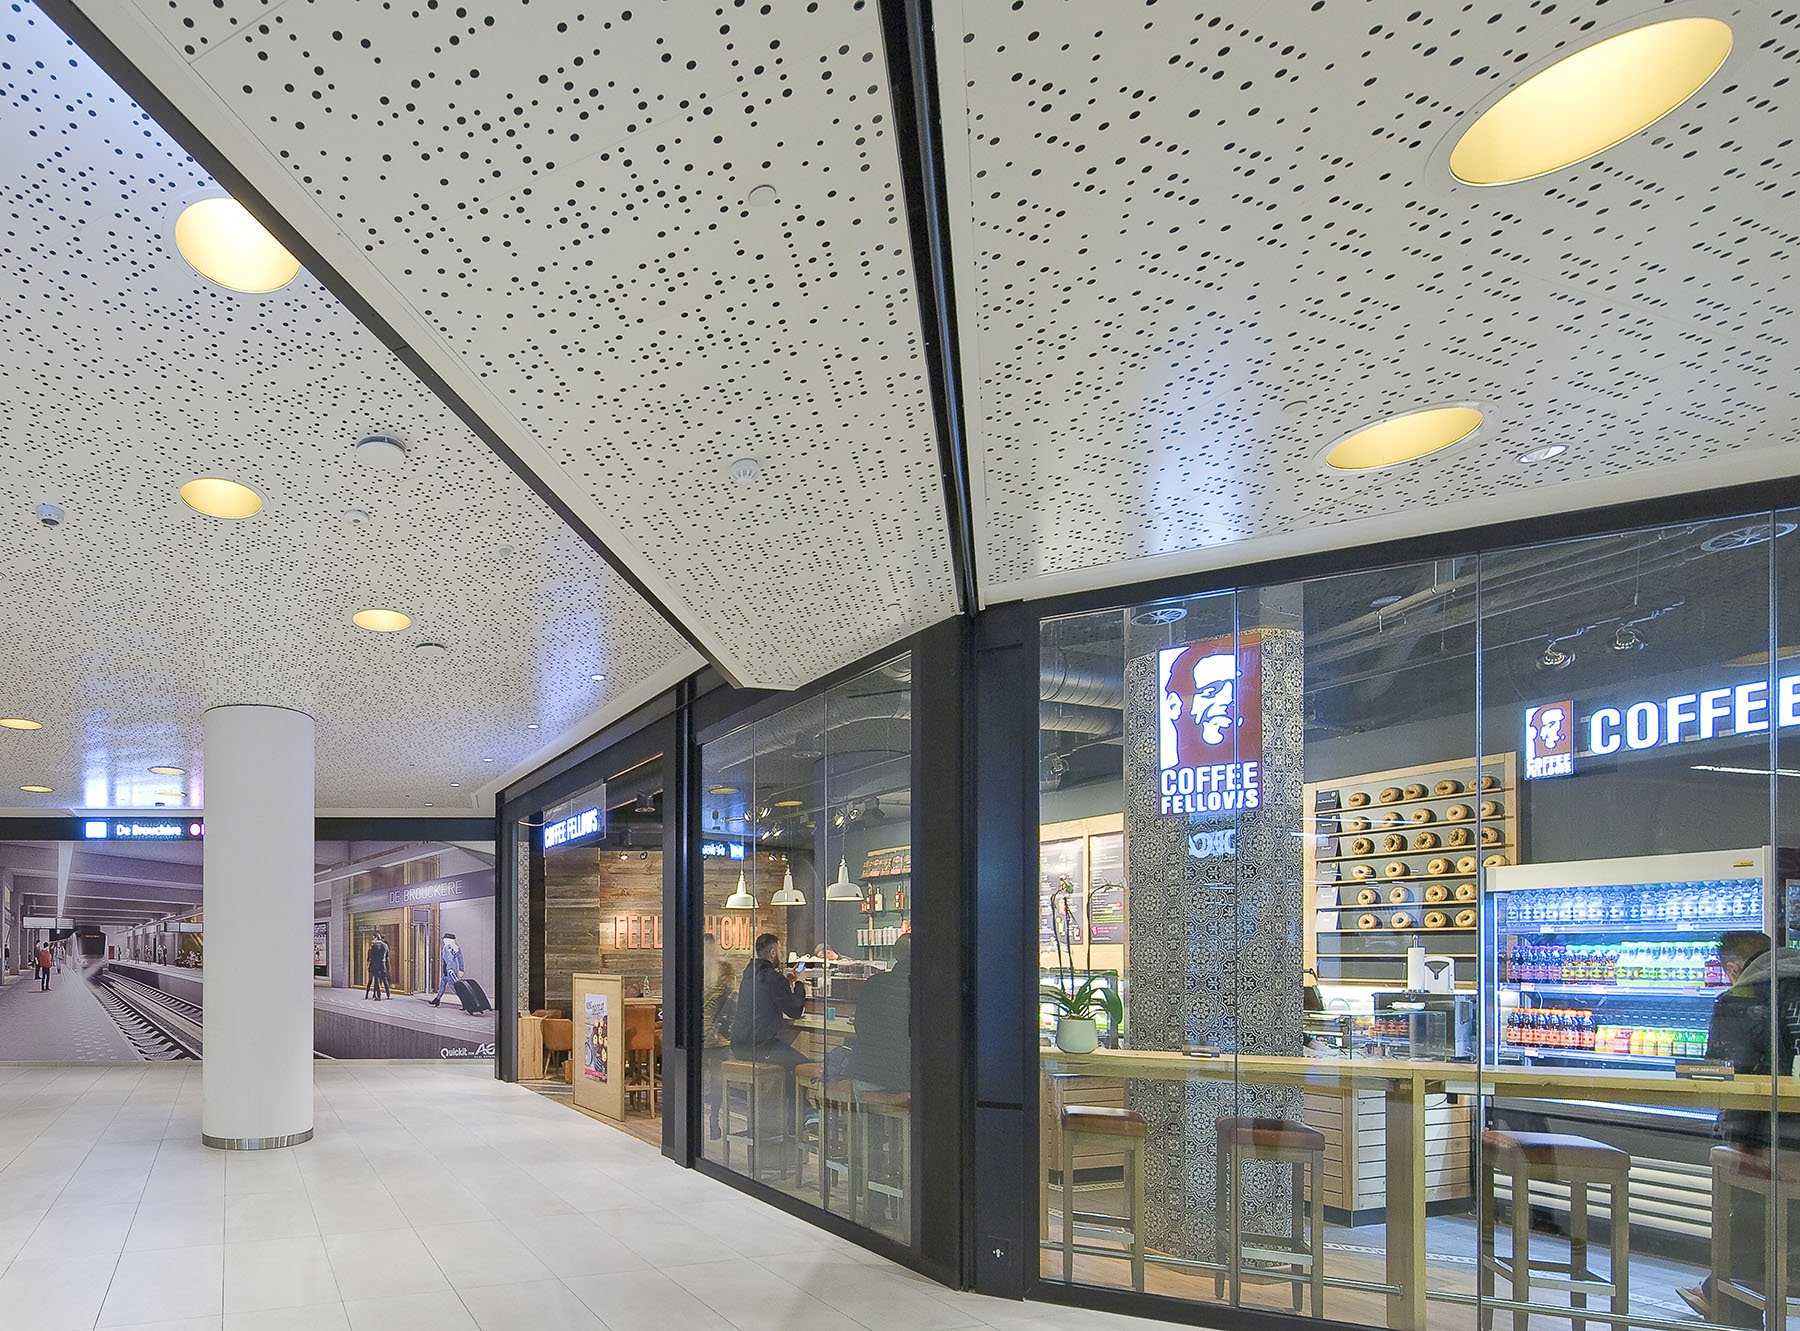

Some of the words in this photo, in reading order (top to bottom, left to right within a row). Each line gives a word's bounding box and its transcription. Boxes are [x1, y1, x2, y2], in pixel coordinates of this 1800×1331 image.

[1590, 675, 1800, 755] COFFEE
[1160, 762, 1259, 796] COFFEE
[1160, 789, 1259, 815] FELLOWS
[389, 891, 401, 904] DE
[403, 880, 462, 902] BROUCKERE
[615, 915, 663, 949] FEEL
[440, 1047, 468, 1059] Quickit
